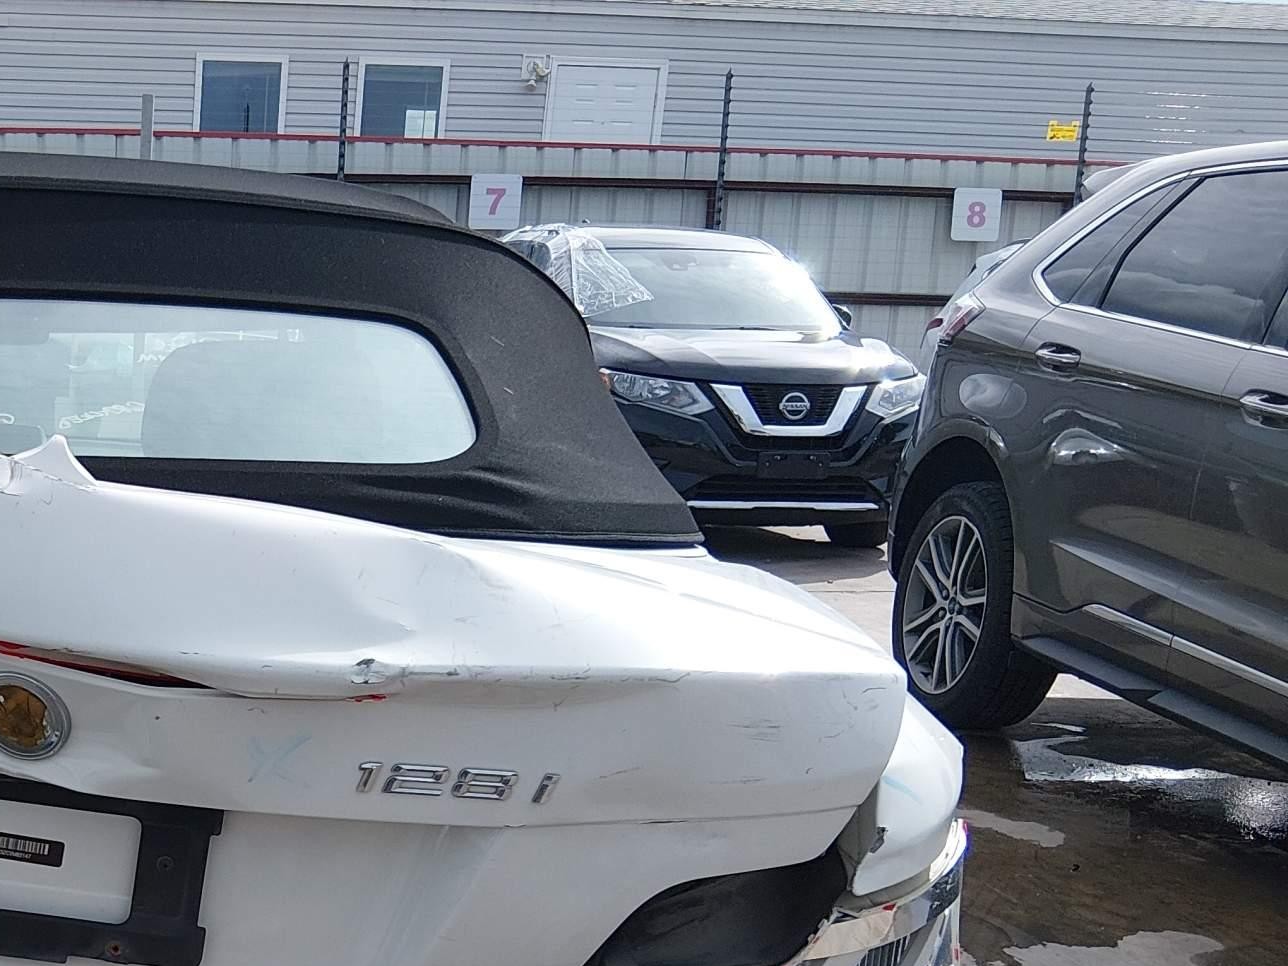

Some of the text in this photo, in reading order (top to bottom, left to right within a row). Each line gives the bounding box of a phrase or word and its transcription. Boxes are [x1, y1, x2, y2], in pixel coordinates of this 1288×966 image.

[486, 188, 506, 216] 7
[966, 201, 986, 228] 8
[355, 761, 560, 803] 128i
